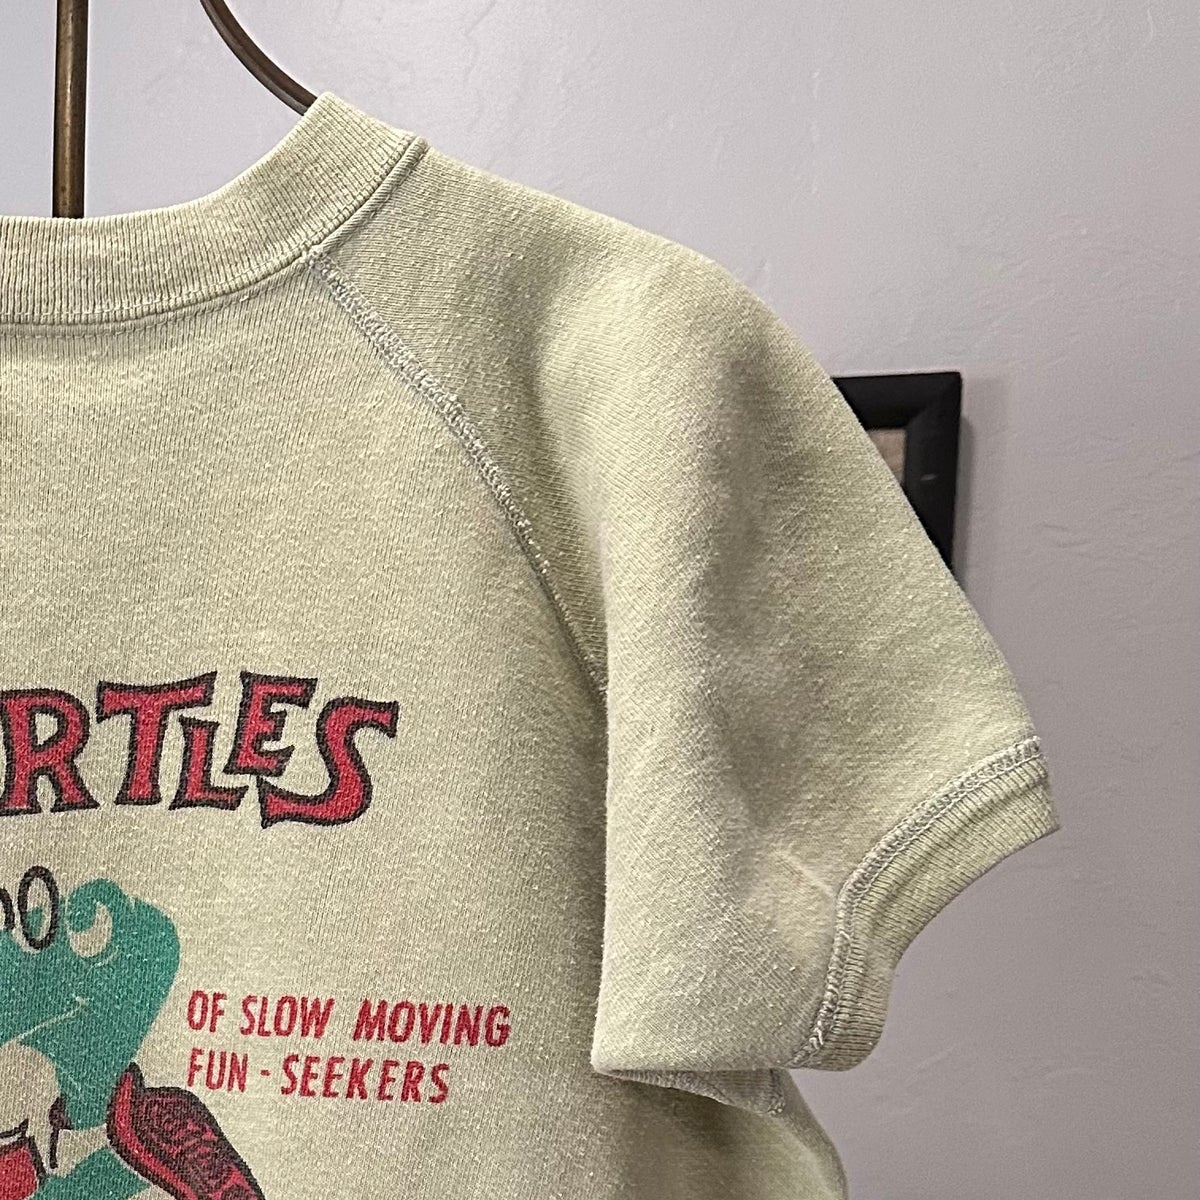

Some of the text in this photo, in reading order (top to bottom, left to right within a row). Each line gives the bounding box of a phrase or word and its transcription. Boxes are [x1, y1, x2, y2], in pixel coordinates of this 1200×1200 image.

[189, 992, 510, 1047] OF SLOW MOVING
